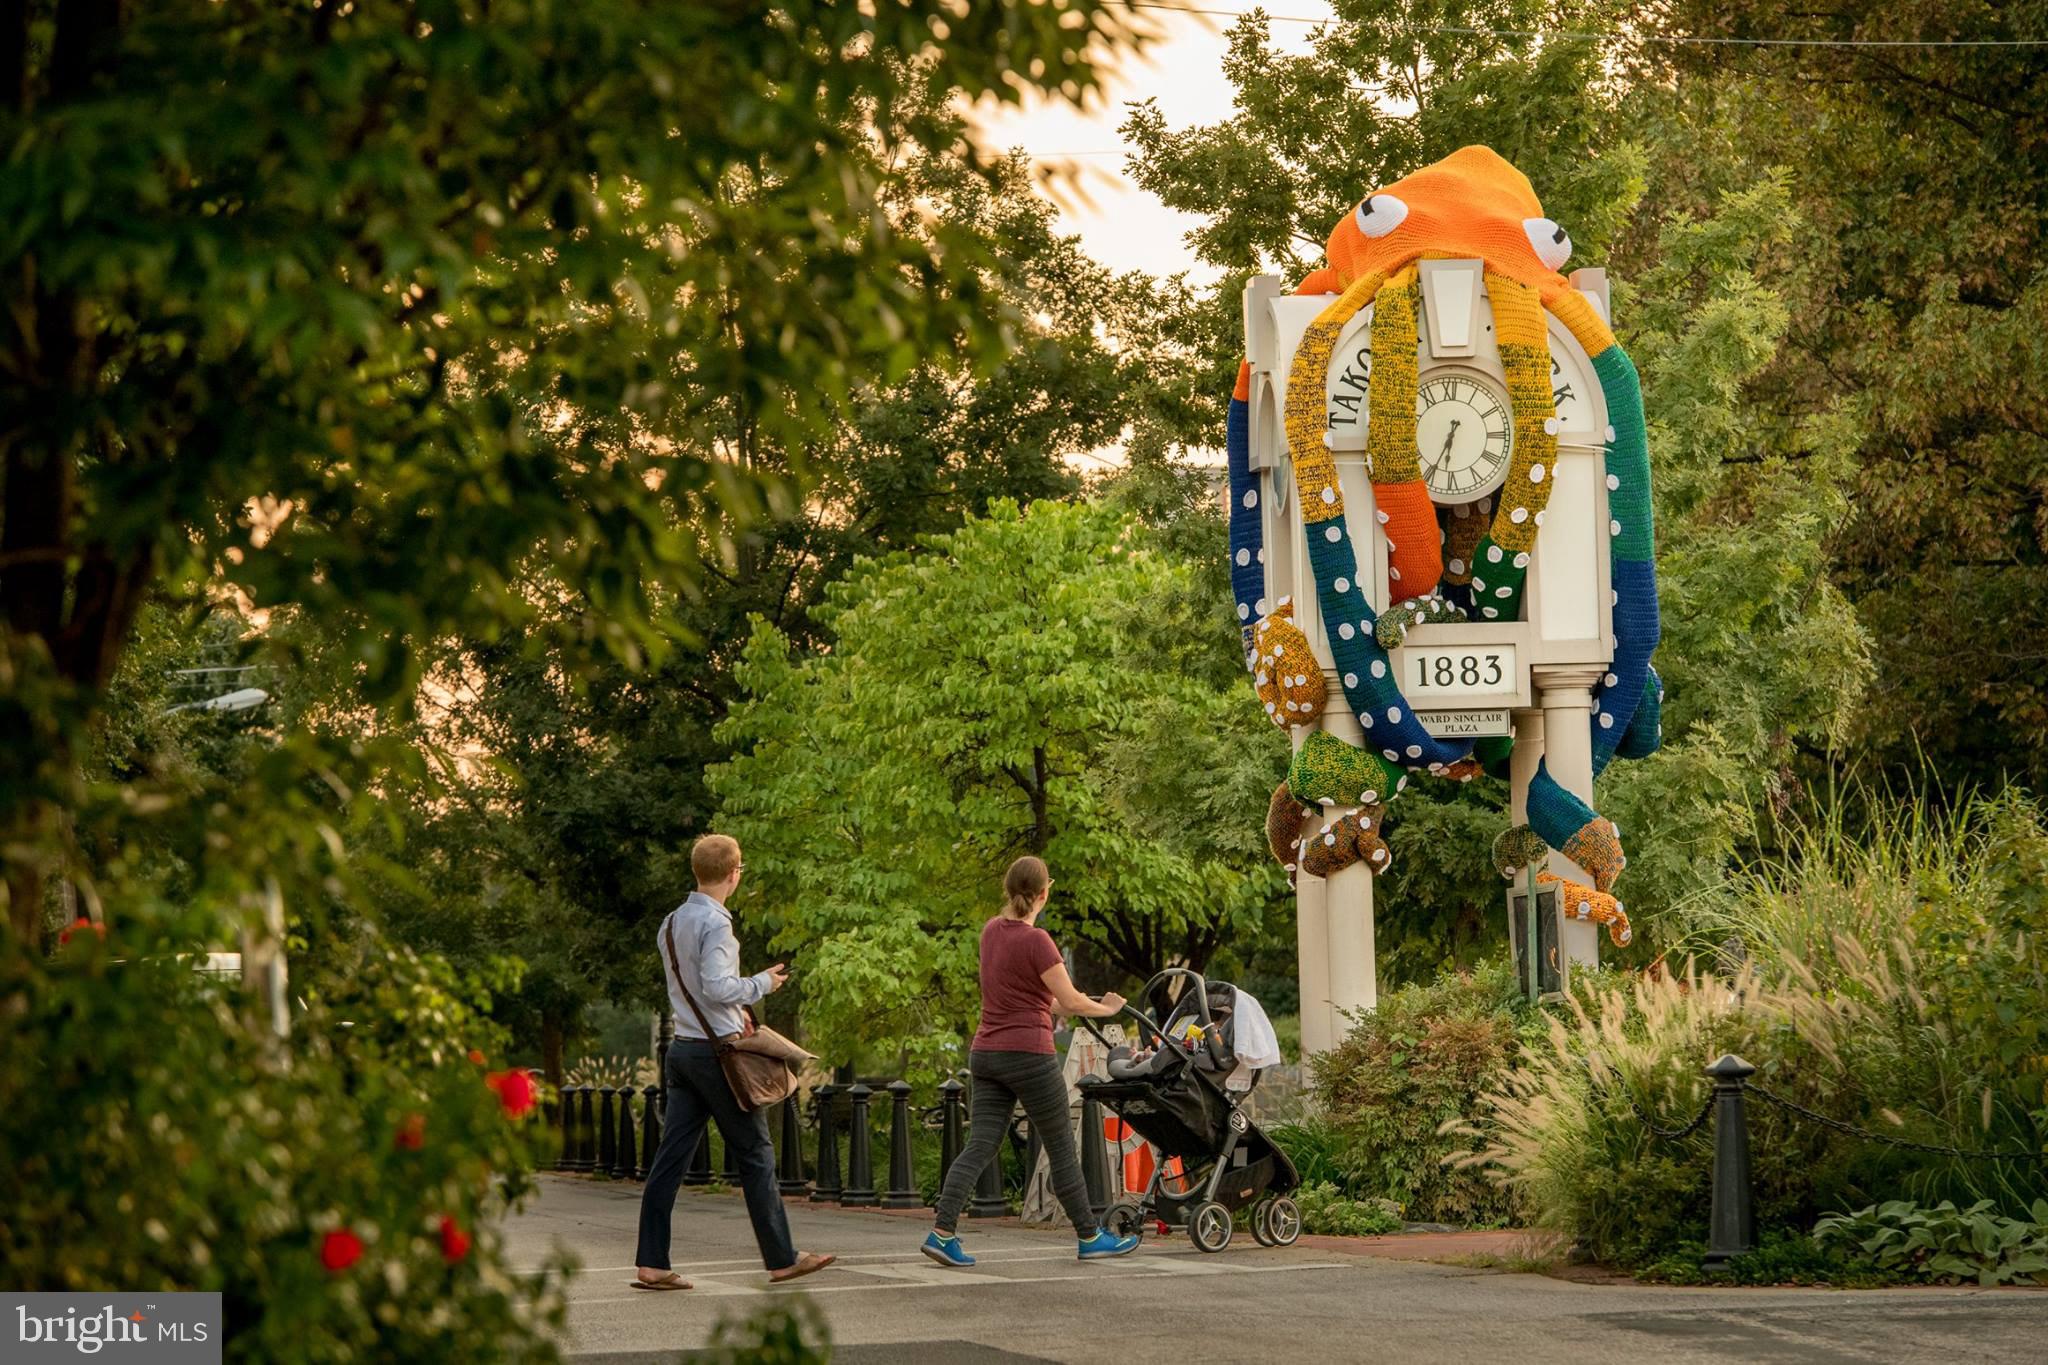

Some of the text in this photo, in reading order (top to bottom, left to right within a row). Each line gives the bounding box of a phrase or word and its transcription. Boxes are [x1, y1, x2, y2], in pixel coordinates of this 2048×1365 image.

[1417, 655, 1502, 687] 1883
[1420, 714, 1502, 723] WARD SINCLAIR
